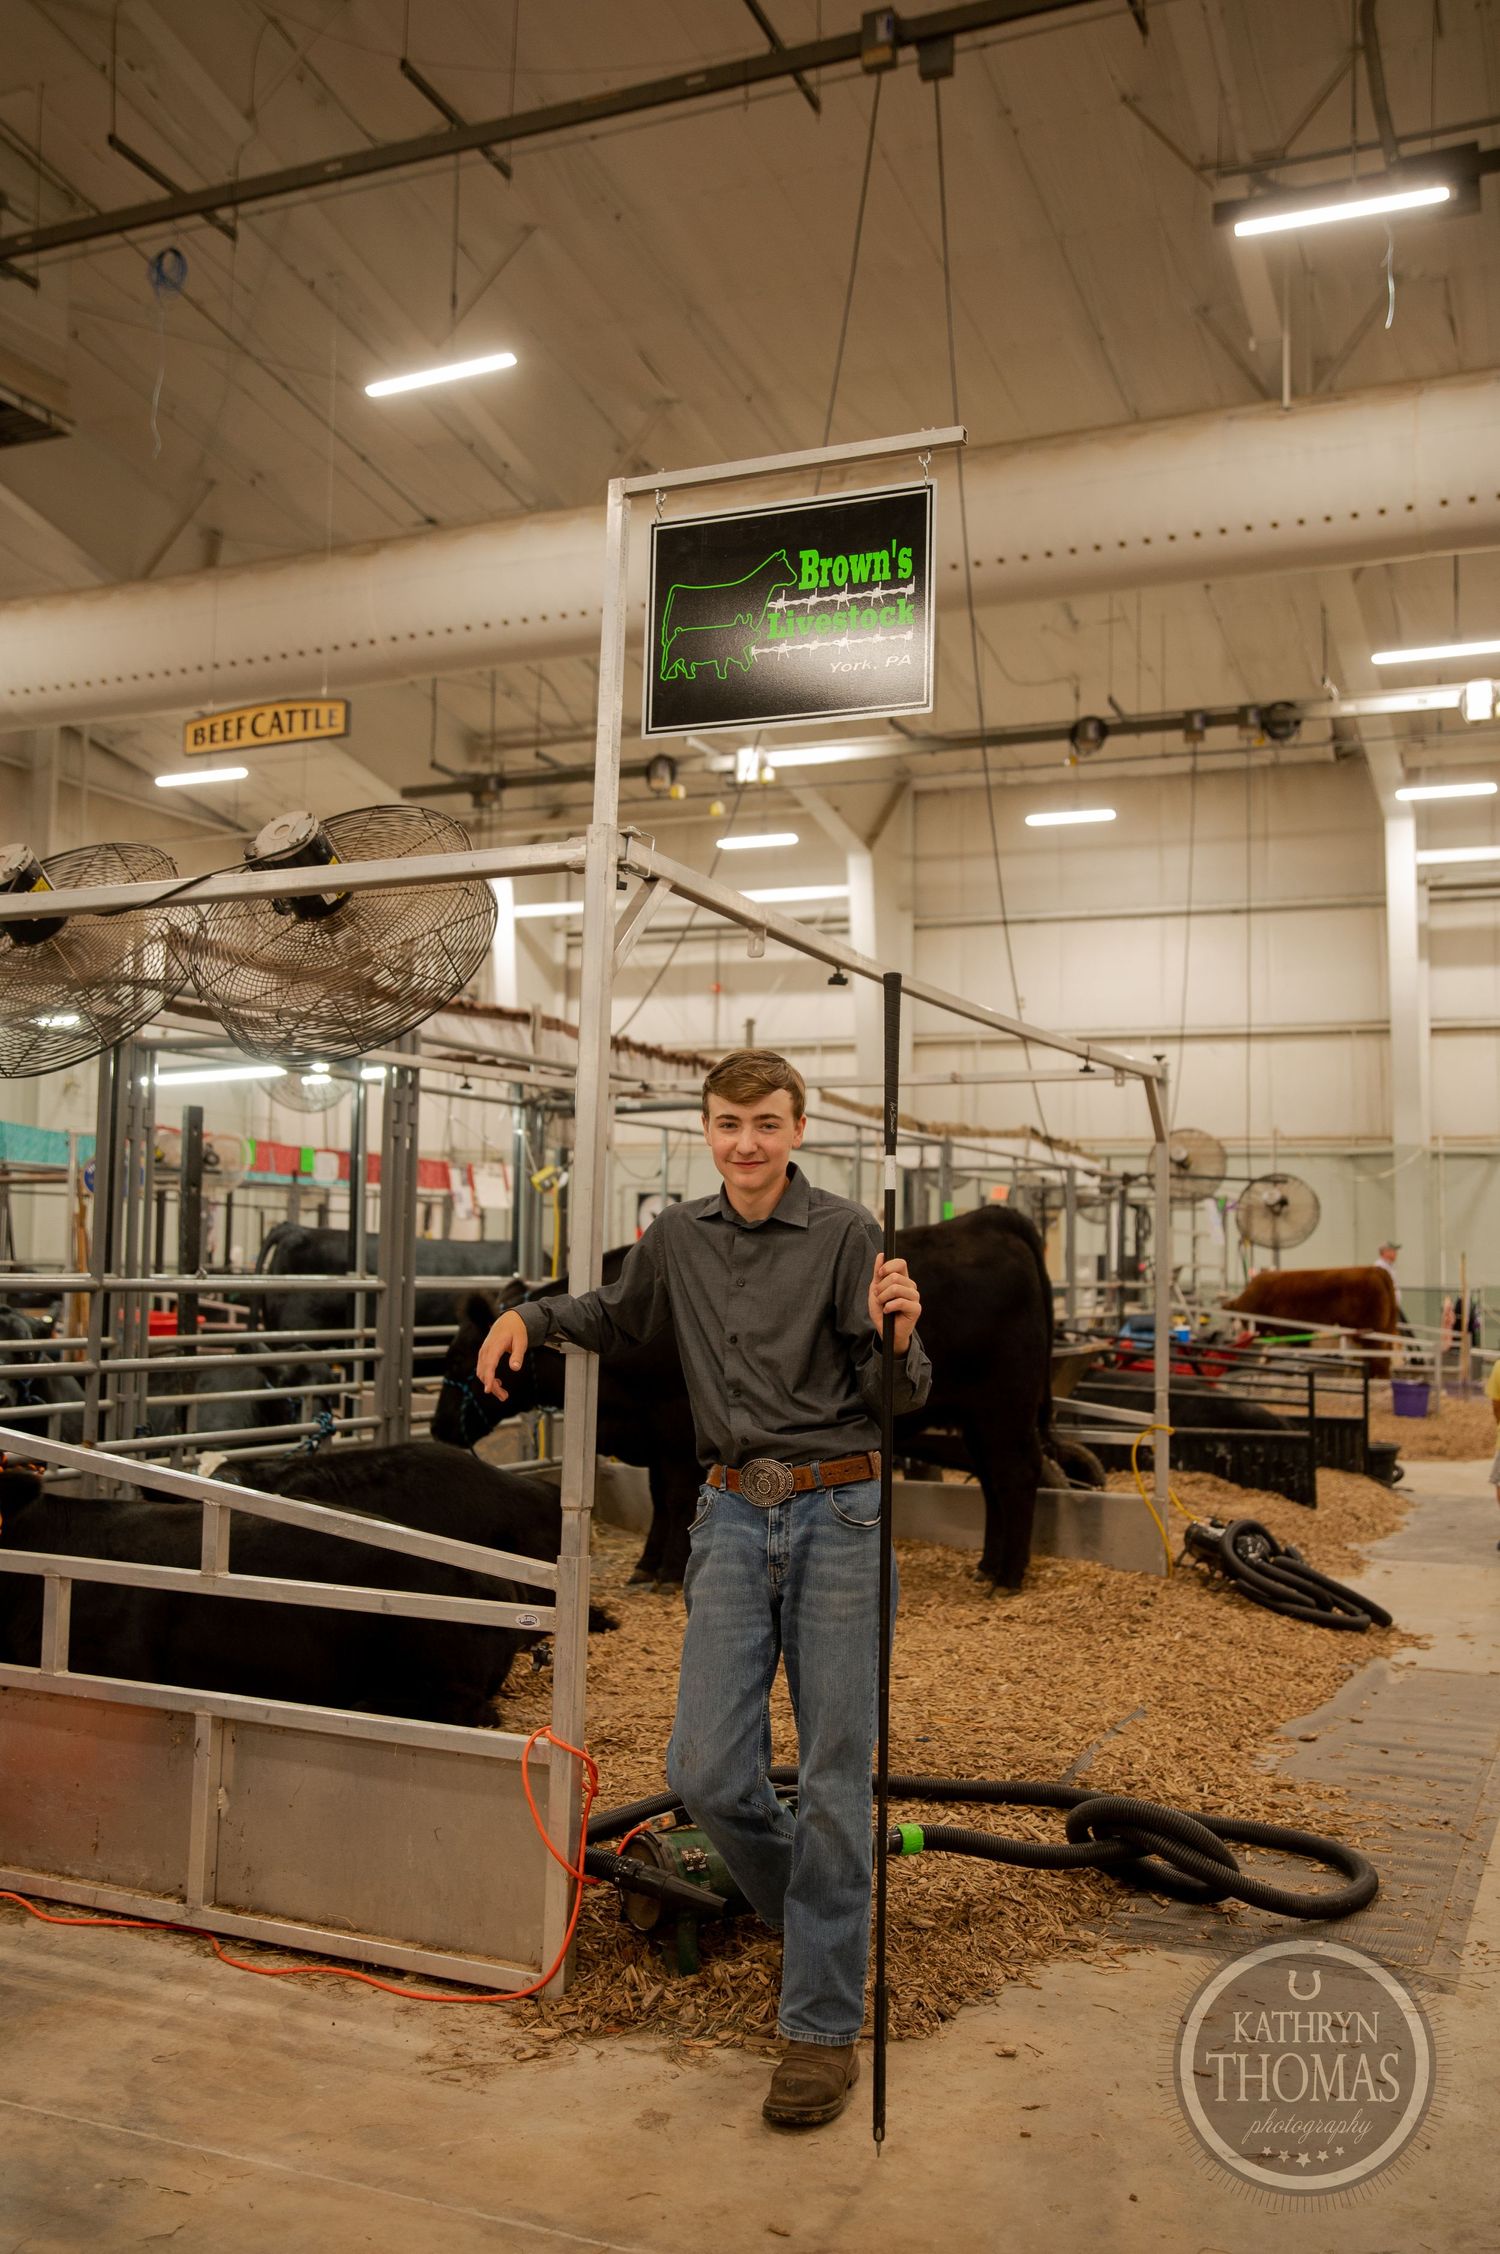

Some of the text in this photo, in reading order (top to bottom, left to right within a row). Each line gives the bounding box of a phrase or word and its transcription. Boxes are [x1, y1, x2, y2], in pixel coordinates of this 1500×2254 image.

[798, 539, 913, 590] Brown's
[767, 598, 916, 640] Livestock
[885, 654, 912, 668] PA
